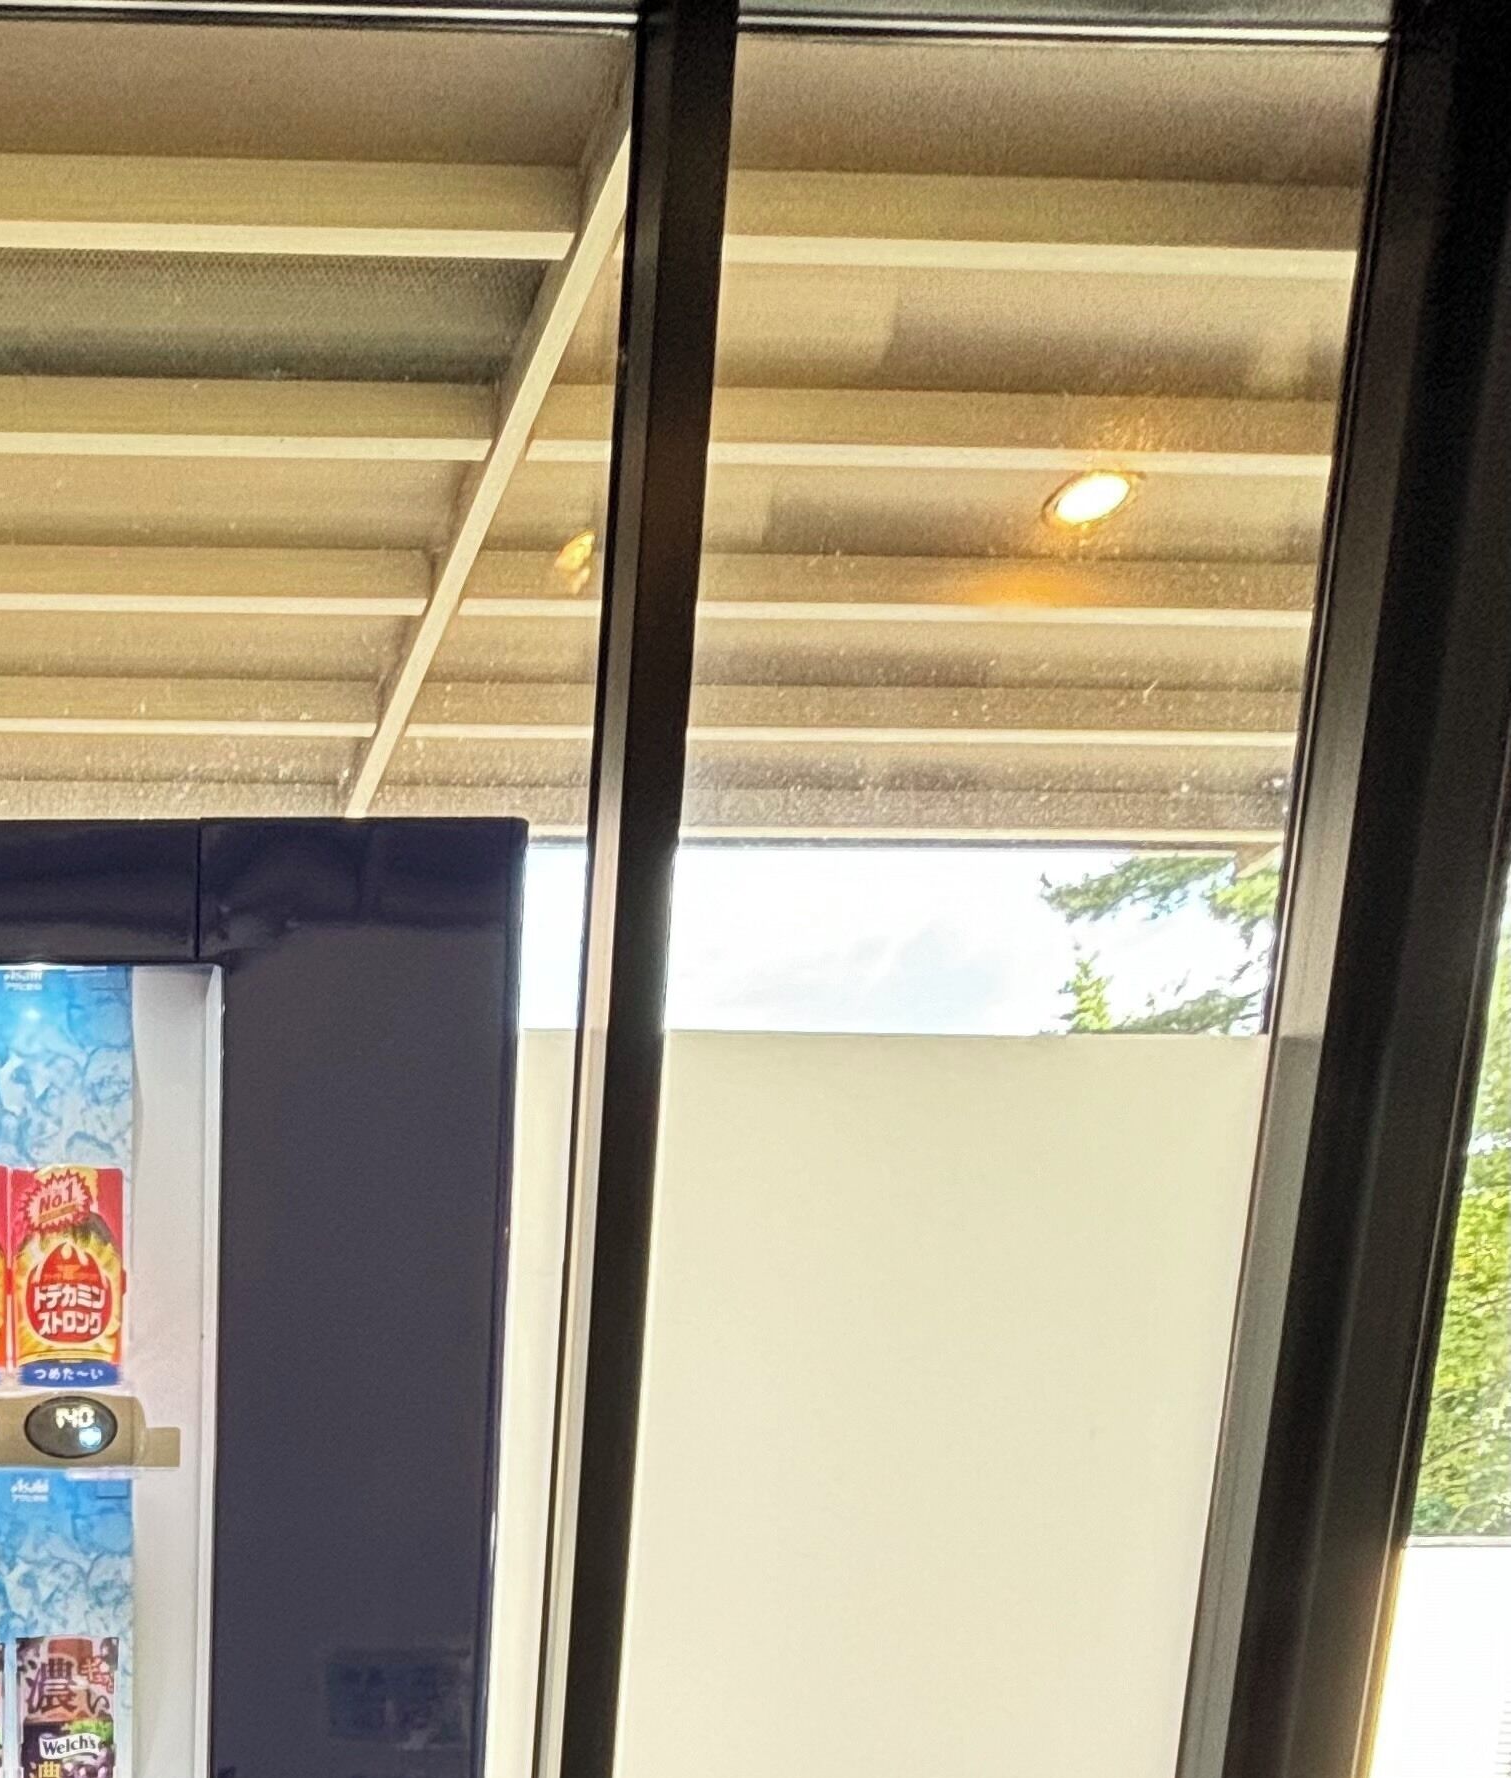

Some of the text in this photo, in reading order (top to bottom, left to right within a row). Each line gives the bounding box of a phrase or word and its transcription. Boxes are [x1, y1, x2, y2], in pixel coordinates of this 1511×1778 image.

[37, 1310, 103, 1336] ストロング
[56, 1406, 95, 1430] 140
[42, 1735, 96, 1757] Welch's
